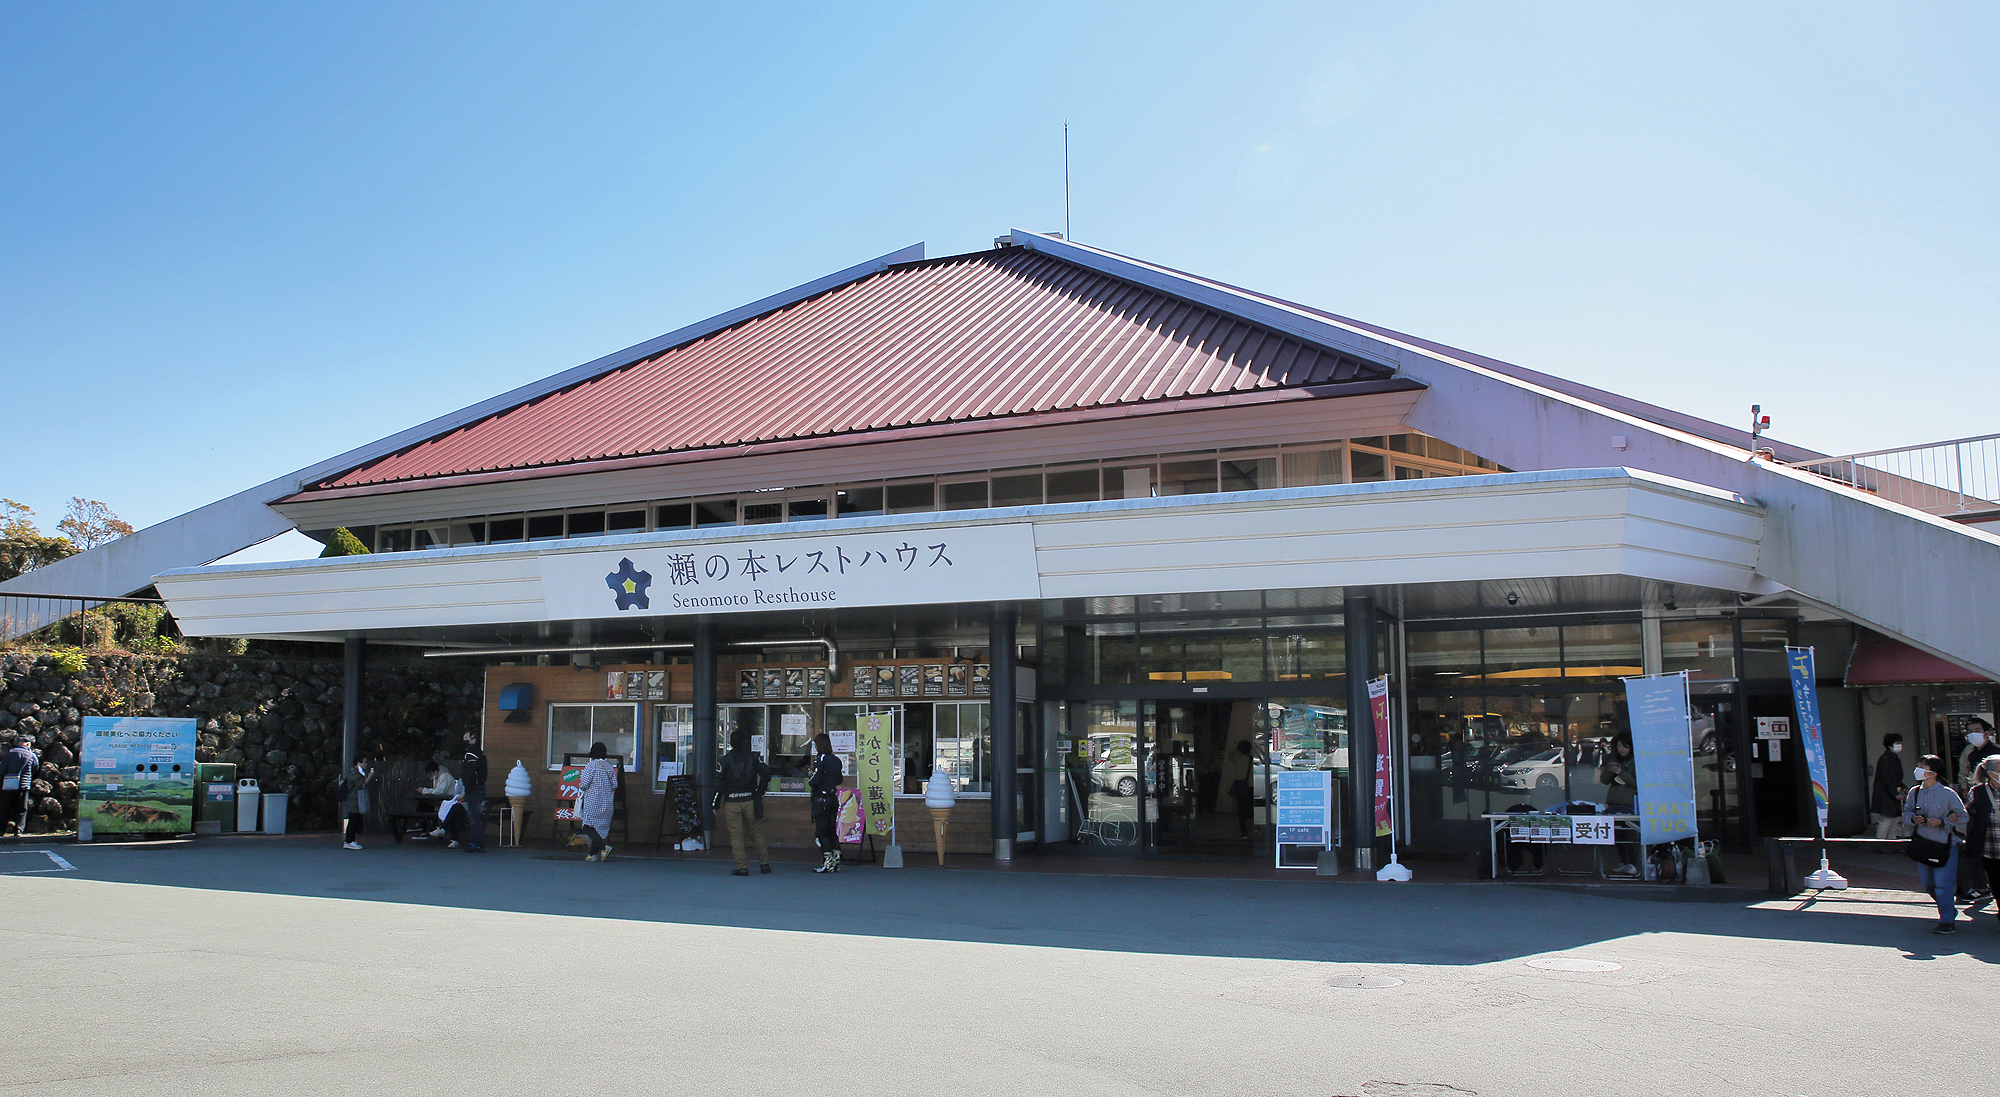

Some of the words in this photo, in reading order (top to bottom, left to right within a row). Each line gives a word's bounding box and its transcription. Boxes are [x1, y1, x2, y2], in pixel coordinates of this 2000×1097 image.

[667, 541, 954, 587] 瀬の本レストハウス
[672, 594, 749, 610] Senomoto
[753, 587, 837, 606] Resthouse
[1575, 822, 1611, 839] 受付
